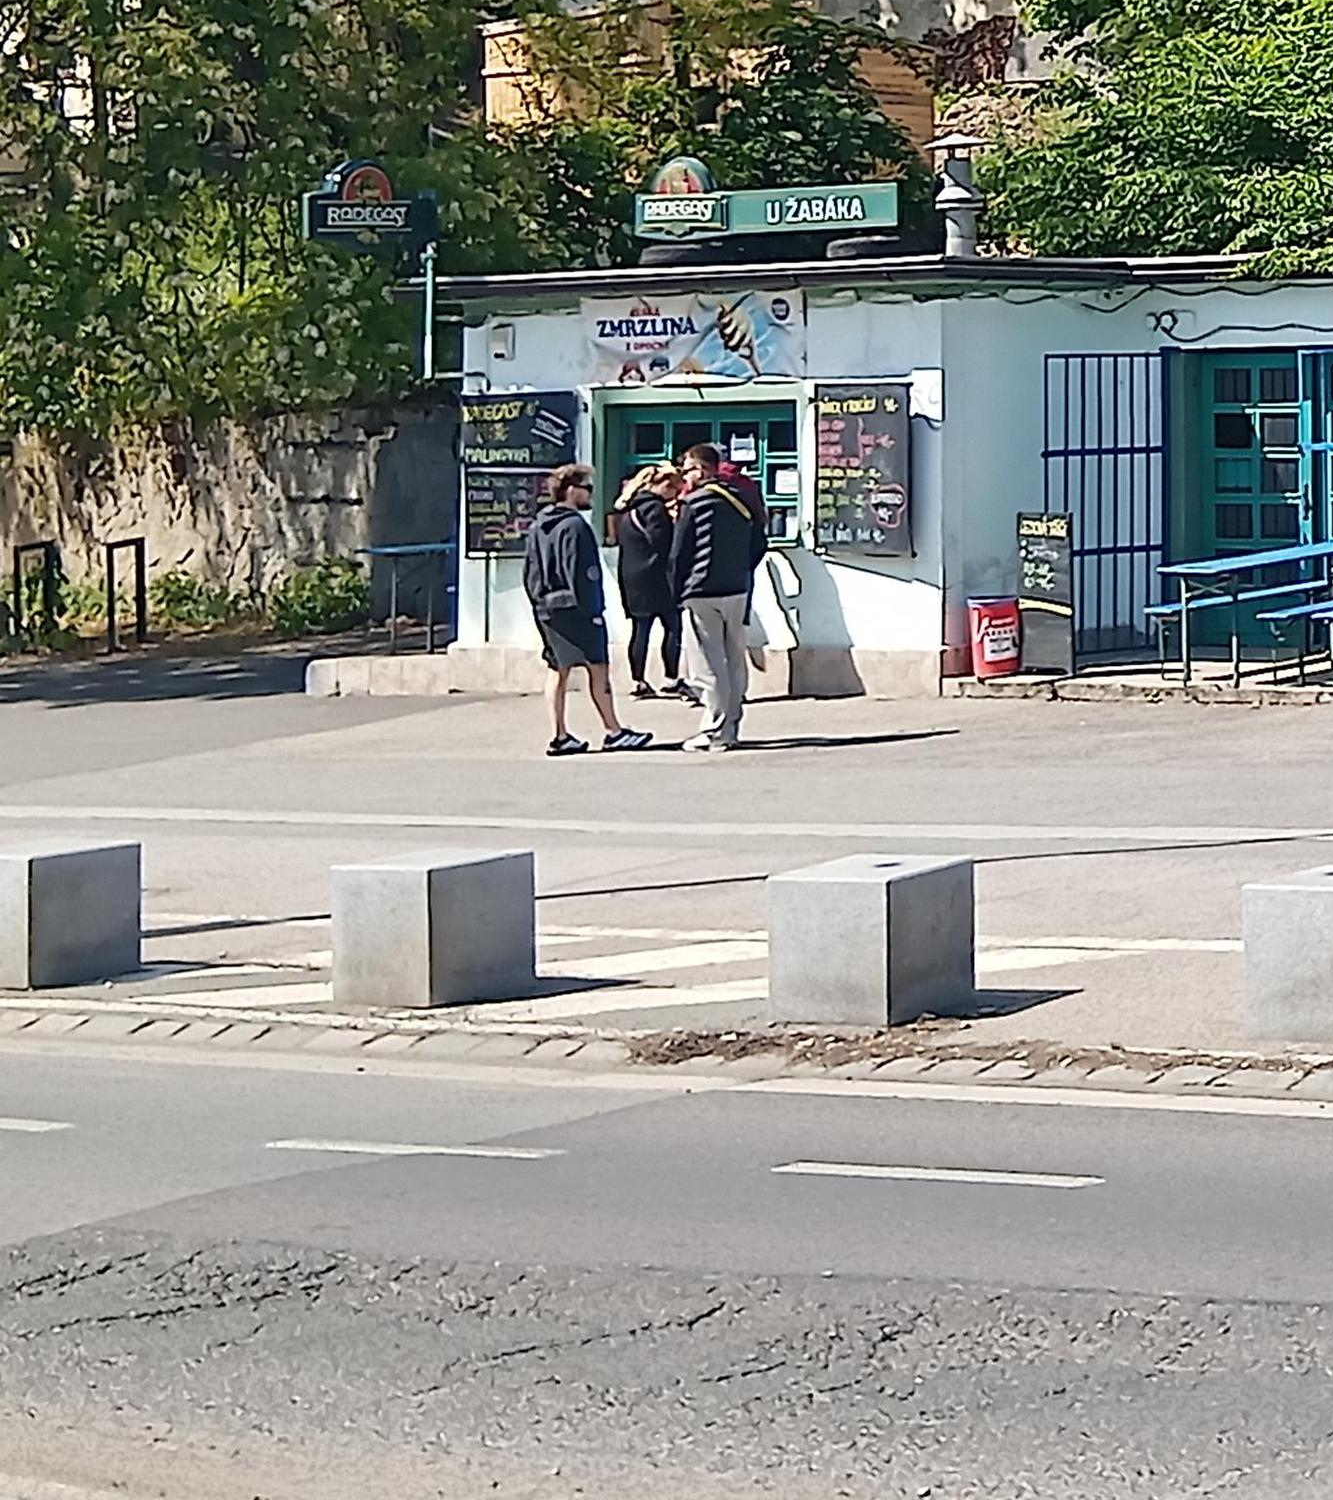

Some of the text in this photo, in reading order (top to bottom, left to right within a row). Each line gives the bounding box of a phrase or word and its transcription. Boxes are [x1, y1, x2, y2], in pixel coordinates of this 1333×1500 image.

[326, 206, 408, 228] RADEGAST
[643, 199, 716, 222] RADEGAST
[765, 193, 865, 224] U ŽABÁKA
[596, 315, 701, 338] ZMRZLINA
